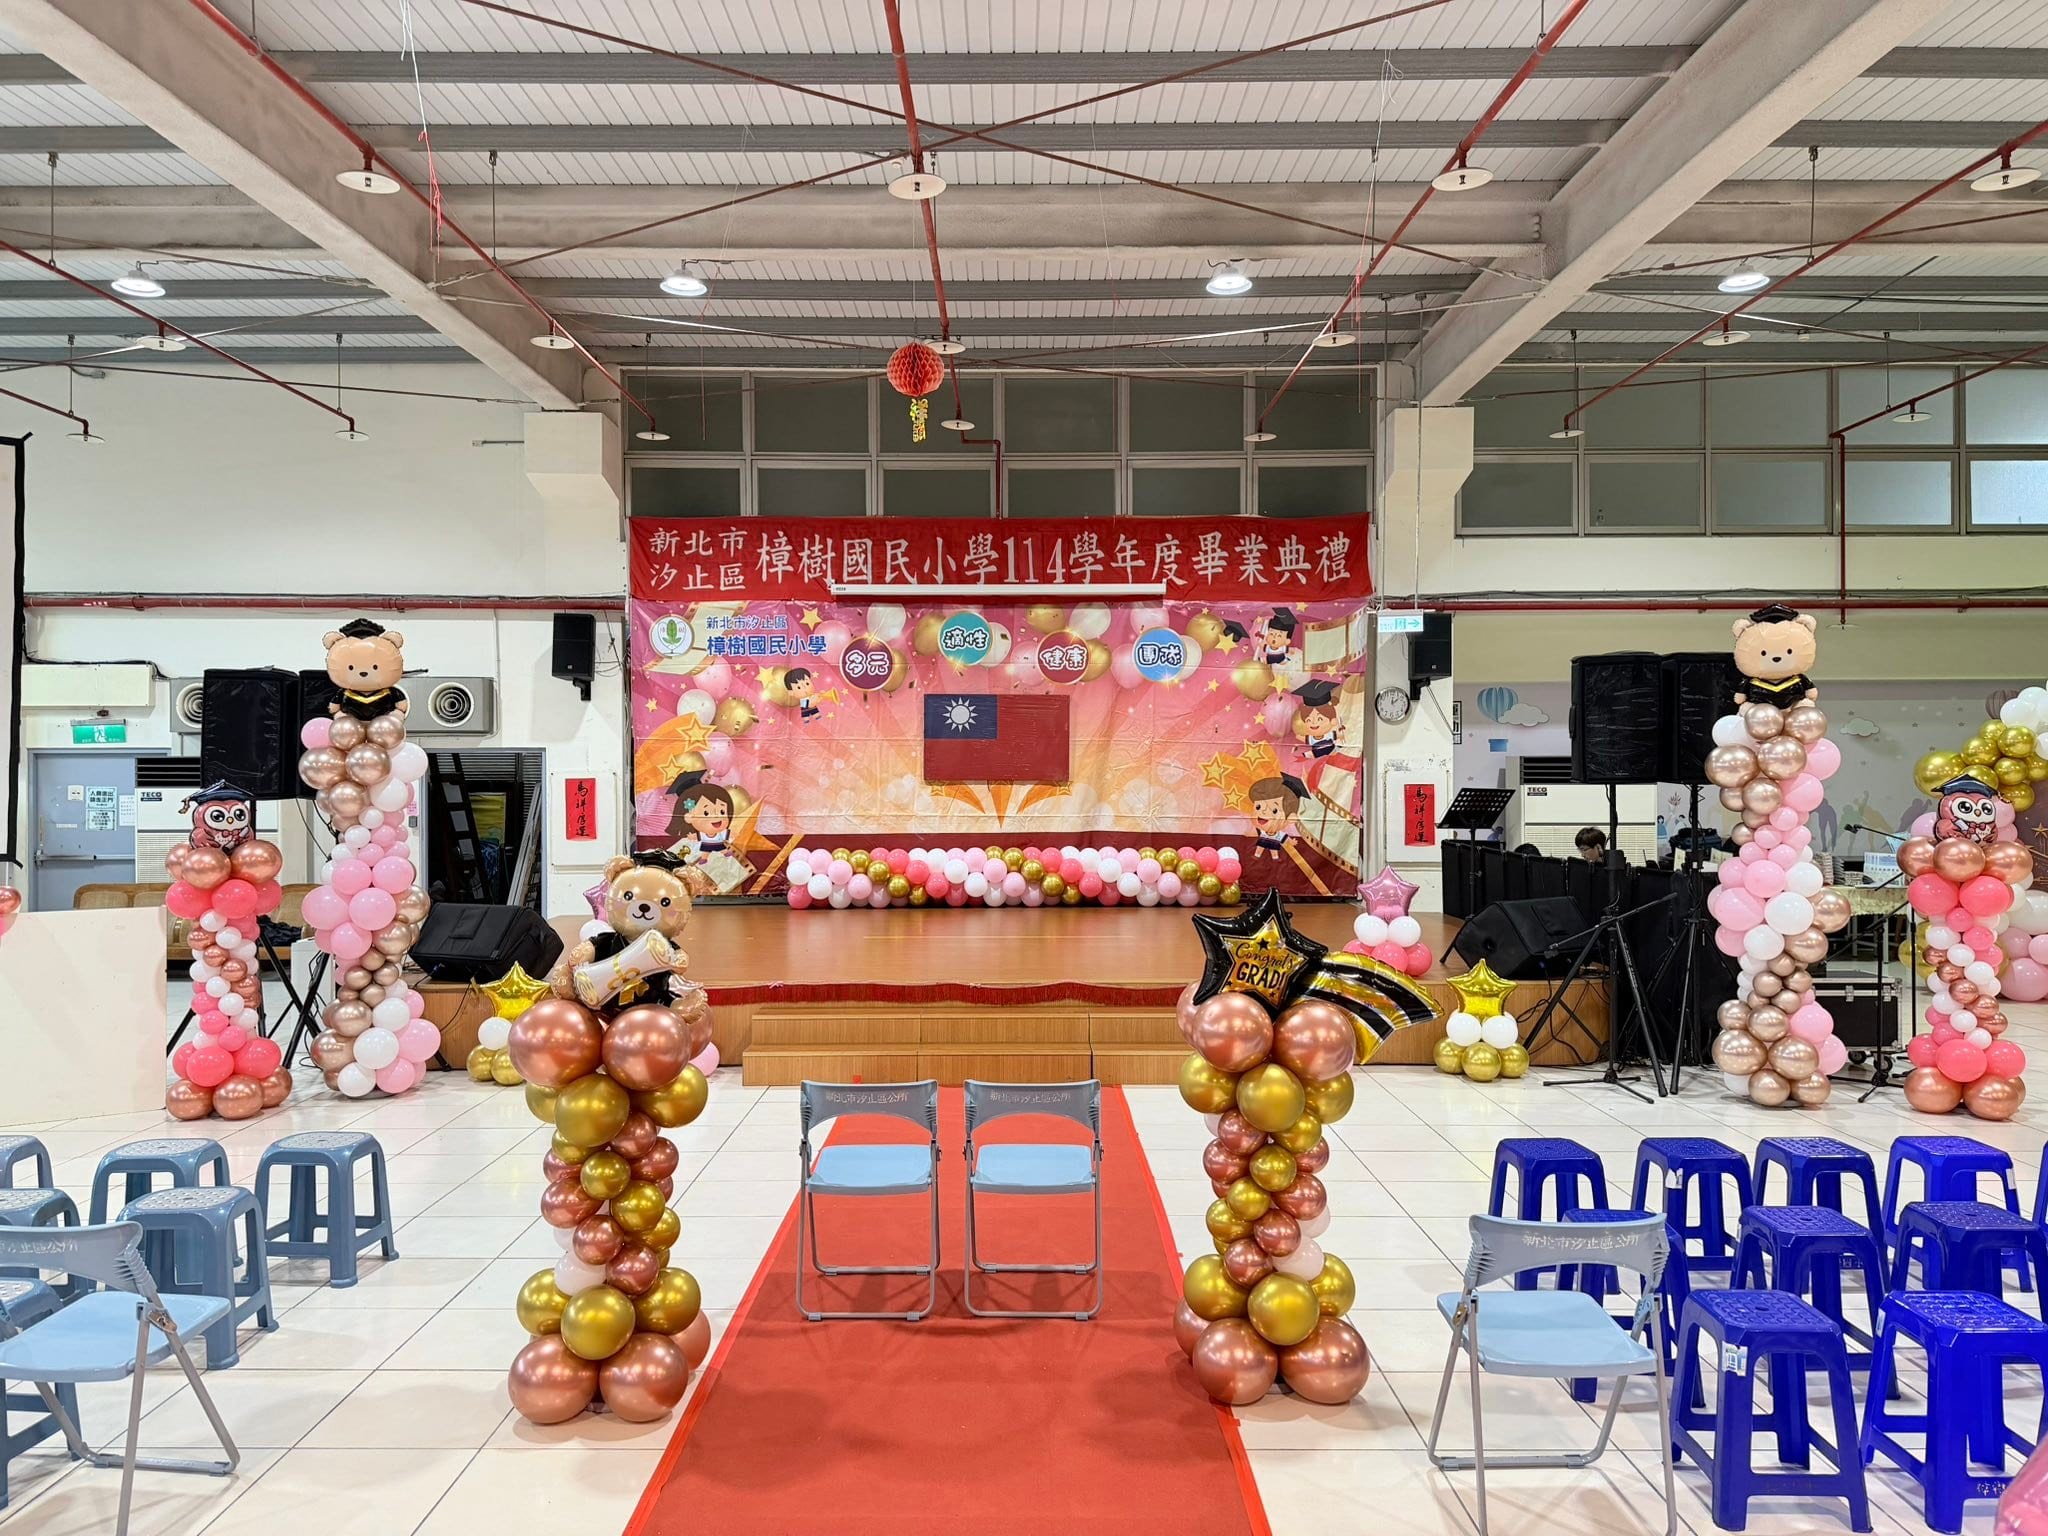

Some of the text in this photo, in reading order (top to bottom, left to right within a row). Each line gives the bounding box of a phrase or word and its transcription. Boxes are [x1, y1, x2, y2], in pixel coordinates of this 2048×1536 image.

[649, 526, 748, 558] 新北市
[755, 529, 1352, 587] 樟樹國民小學114學年度畢業典禮
[649, 562, 747, 592] 汐止區
[706, 615, 788, 630] 新北市汐止區
[706, 635, 827, 656] 樟樹國民小學
[942, 626, 989, 651] 適性
[845, 649, 889, 677] 多元
[1040, 645, 1087, 670] 健康
[1136, 642, 1183, 667] 團隊
[1235, 942, 1293, 970] Congrats
[1236, 961, 1286, 991] GRAD!
